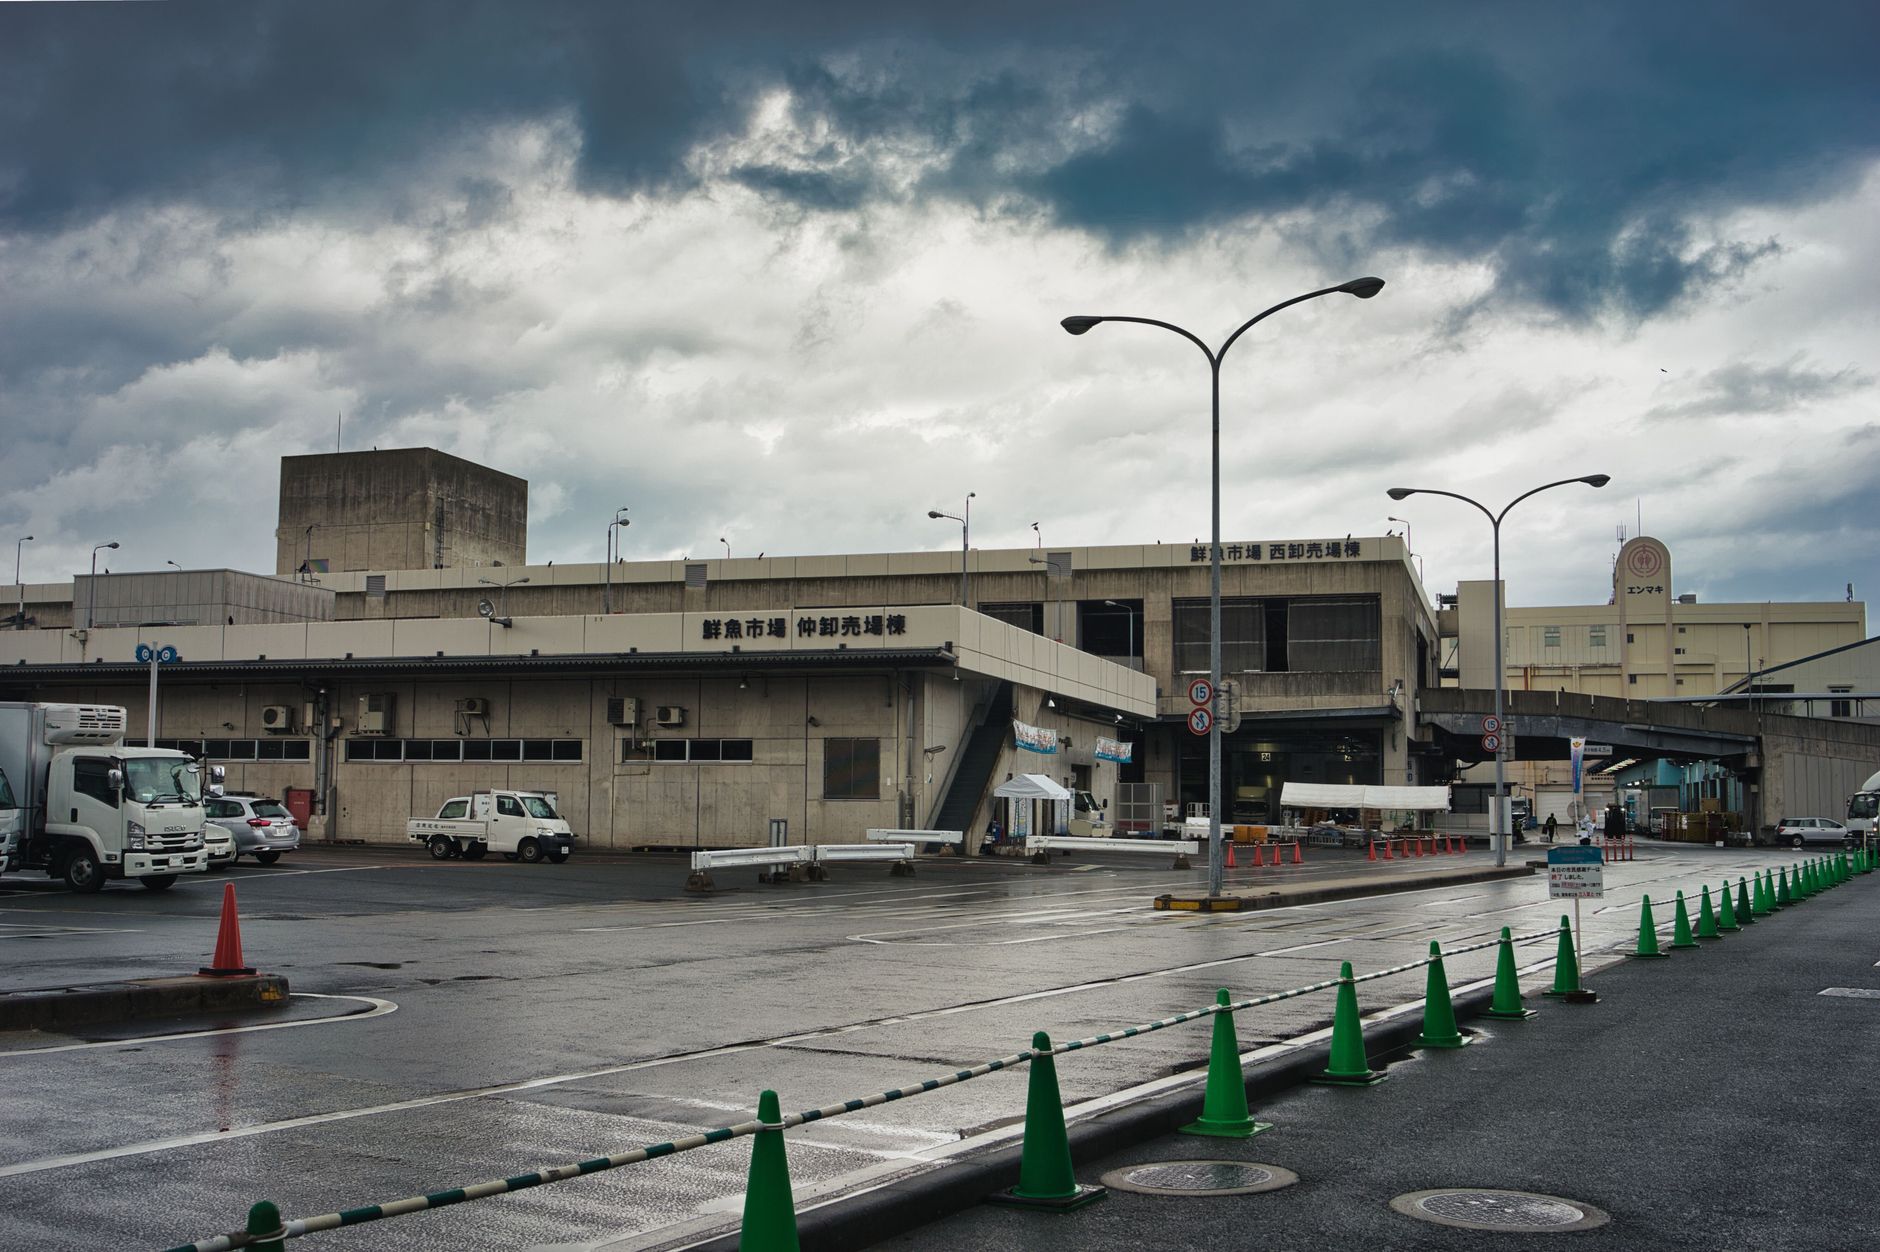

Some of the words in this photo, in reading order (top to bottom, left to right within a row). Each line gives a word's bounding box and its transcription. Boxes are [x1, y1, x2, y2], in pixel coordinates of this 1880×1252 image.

[1270, 541, 1360, 560] 西卸売場棟
[1627, 585, 1663, 594] エンマキ
[702, 618, 786, 640] 鮮魚市場
[797, 614, 906, 638] 仲卸売場棟
[1195, 686, 1206, 699] 15
[1487, 720, 1496, 729] 15
[1262, 753, 1270, 761] 24
